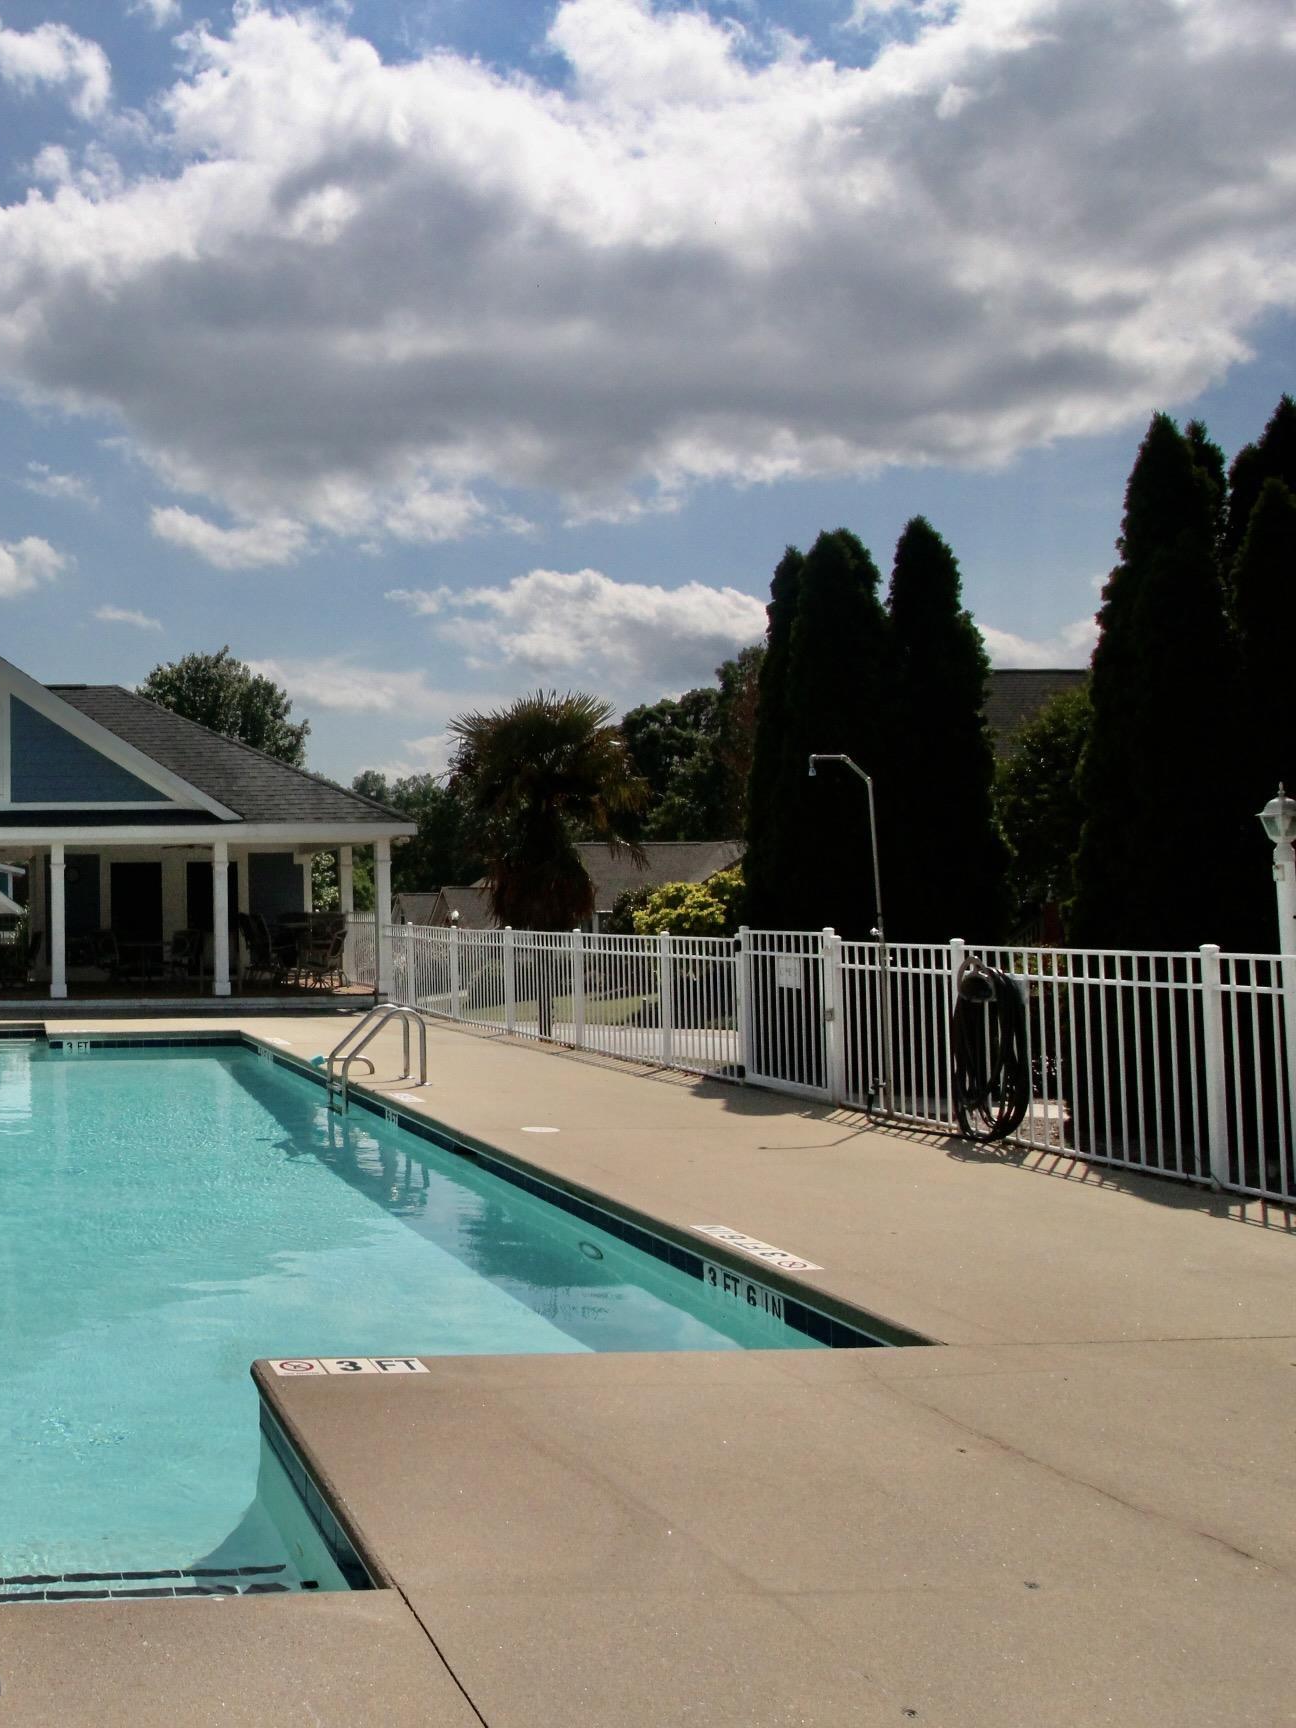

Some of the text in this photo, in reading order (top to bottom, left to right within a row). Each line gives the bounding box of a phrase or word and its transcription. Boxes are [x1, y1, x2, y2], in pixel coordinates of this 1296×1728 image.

[708, 1266, 782, 1321] 3 FT 6 IN
[335, 1358, 417, 1372] 3 FT
